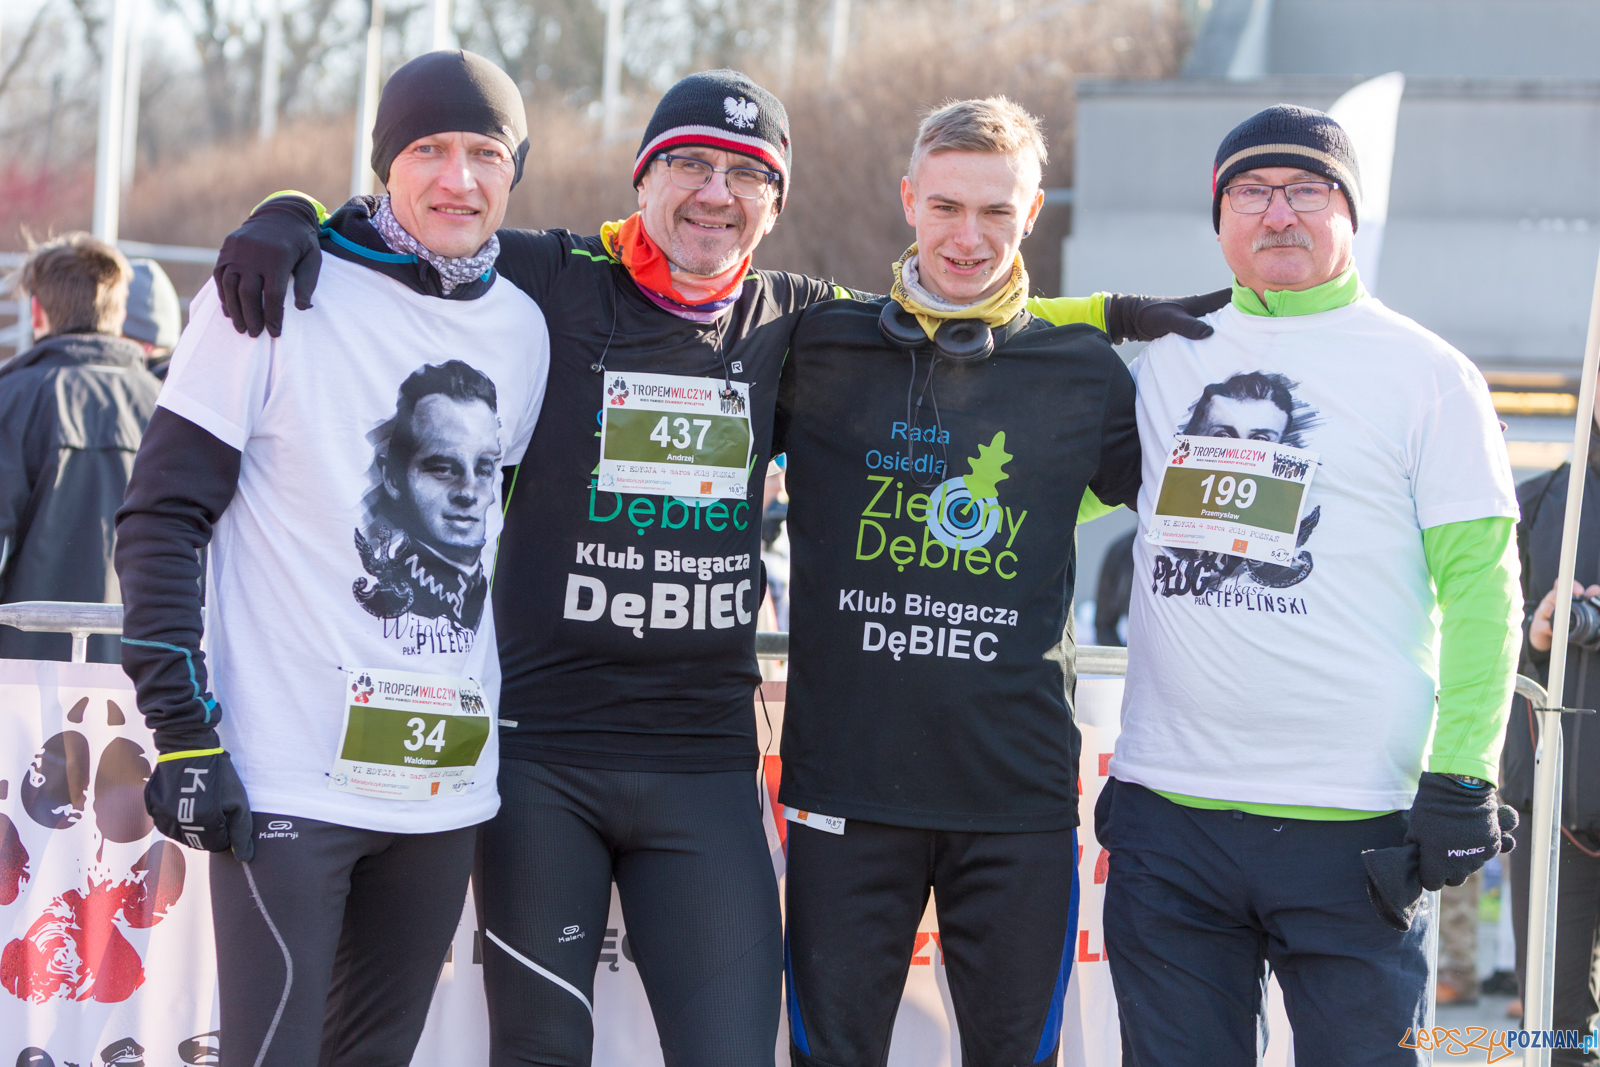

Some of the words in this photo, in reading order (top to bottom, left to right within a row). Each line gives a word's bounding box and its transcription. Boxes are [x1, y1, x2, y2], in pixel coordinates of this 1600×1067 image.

[632, 384, 712, 401] TROPEMWILCZYM
[650, 416, 712, 450] 437
[891, 421, 950, 444] Rada
[666, 453, 694, 463] Andrzej
[865, 450, 946, 475] Osiedla
[1193, 446, 1267, 463] TROPEMWILCZYM
[616, 464, 626, 472] VI
[629, 466, 658, 474] EDYCJA
[694, 469, 710, 477] 2018
[1200, 474, 1257, 509] 199
[1200, 509, 1240, 520] Przemysław
[1173, 520, 1196, 528] EDYCJA
[1228, 527, 1246, 536] 2018
[855, 519, 1018, 580] Dębiec
[575, 542, 644, 570] Klub
[654, 550, 750, 581] Biegacza
[563, 573, 752, 639] DęBIEC
[838, 589, 897, 614] Klub
[904, 593, 1019, 626] Biegacza
[862, 621, 999, 662] DęBIEC
[378, 681, 457, 700] TROPEMWILCZYM
[403, 717, 446, 752] 34
[404, 756, 438, 766] Waldemar
[352, 766, 362, 774] VI
[366, 768, 396, 778] EDYCJA
[258, 831, 299, 840] Kalenji
